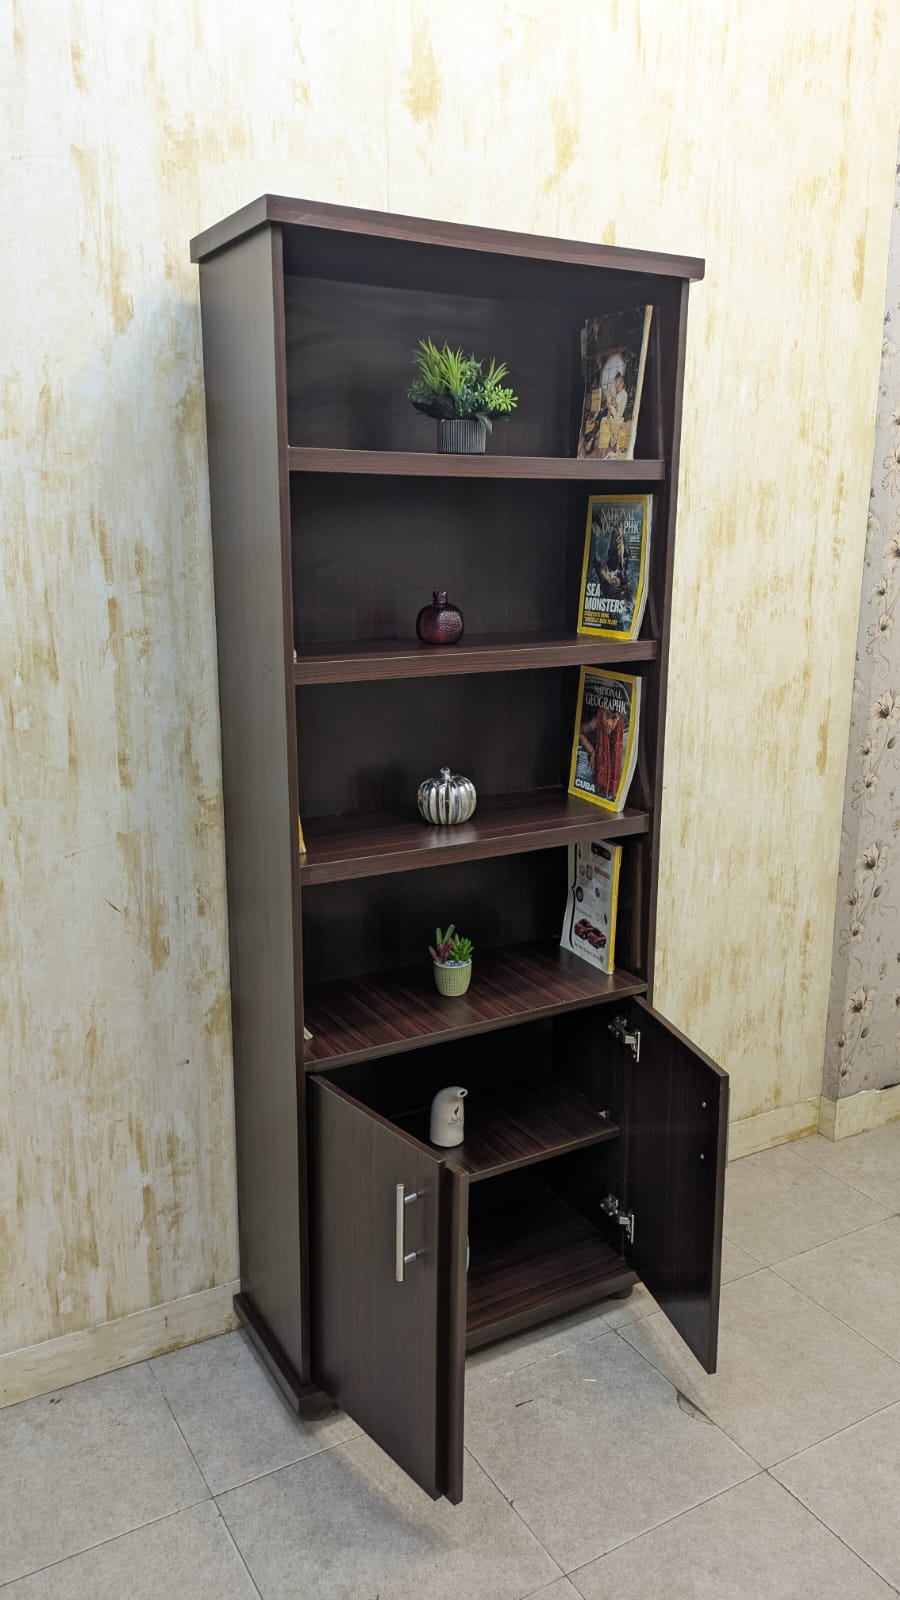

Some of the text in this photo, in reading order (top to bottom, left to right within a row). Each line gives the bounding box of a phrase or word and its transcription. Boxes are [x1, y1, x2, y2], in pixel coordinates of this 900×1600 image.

[586, 583, 601, 597] SEA
[584, 597, 625, 613] MONSTERS
[594, 685, 622, 700] NATIONAL
[585, 693, 628, 714] GEOGRAPHIC
[575, 778, 596, 793] CUBA
